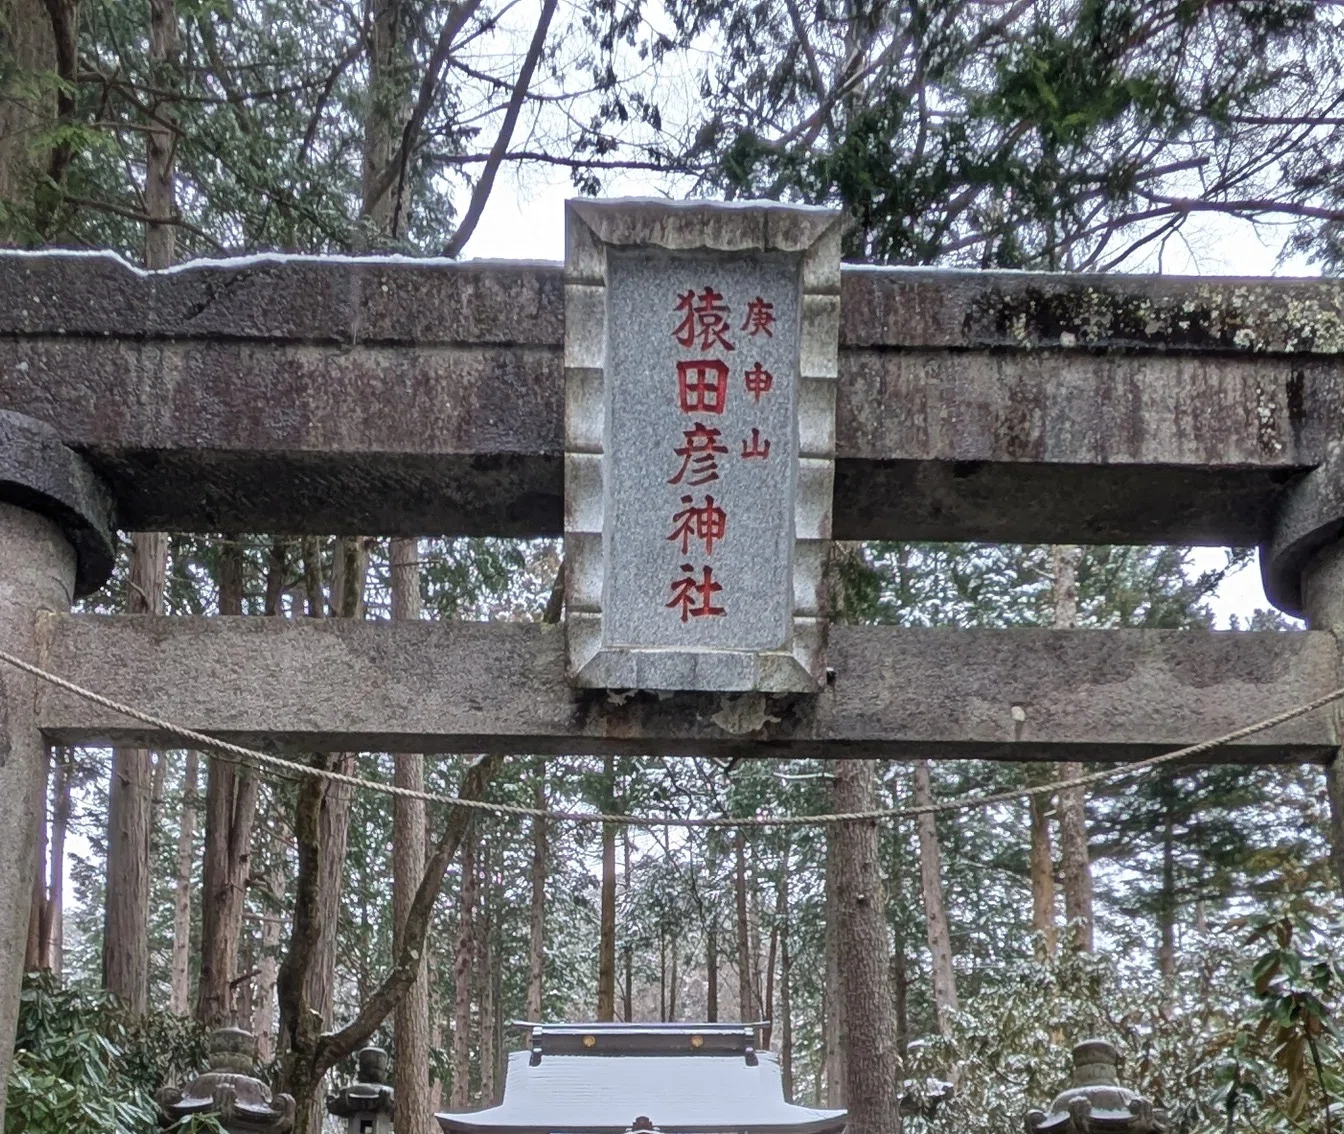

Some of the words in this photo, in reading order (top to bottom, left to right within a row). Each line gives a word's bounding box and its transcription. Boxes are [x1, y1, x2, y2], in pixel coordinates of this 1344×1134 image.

[665, 286, 736, 623] 猿田彦神社
[740, 296, 776, 461] 庚申山
